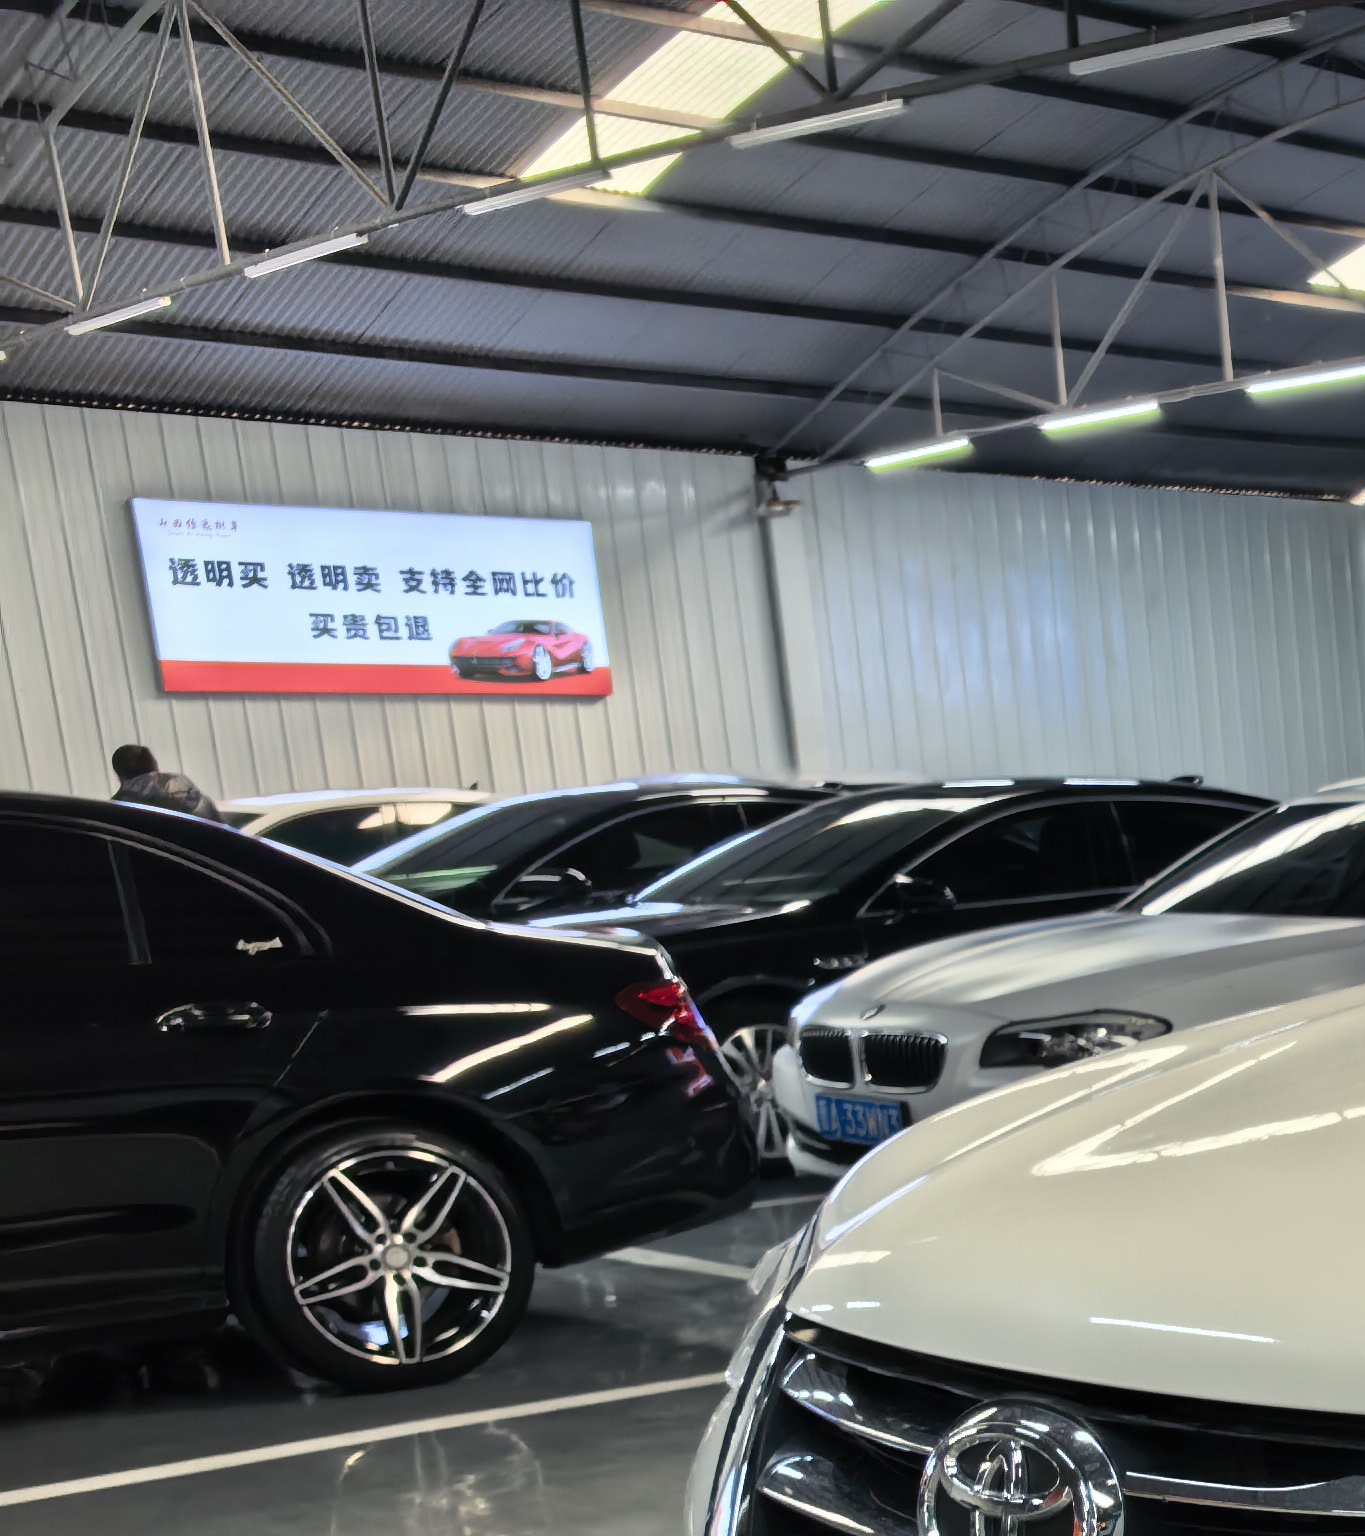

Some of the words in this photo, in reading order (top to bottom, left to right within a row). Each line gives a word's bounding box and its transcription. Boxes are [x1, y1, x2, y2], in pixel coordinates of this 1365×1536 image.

[168, 557, 269, 589] 透明买
[287, 562, 382, 593] 透明卖
[399, 567, 576, 598] 支持全网比价
[308, 612, 433, 641] 买贵包退
